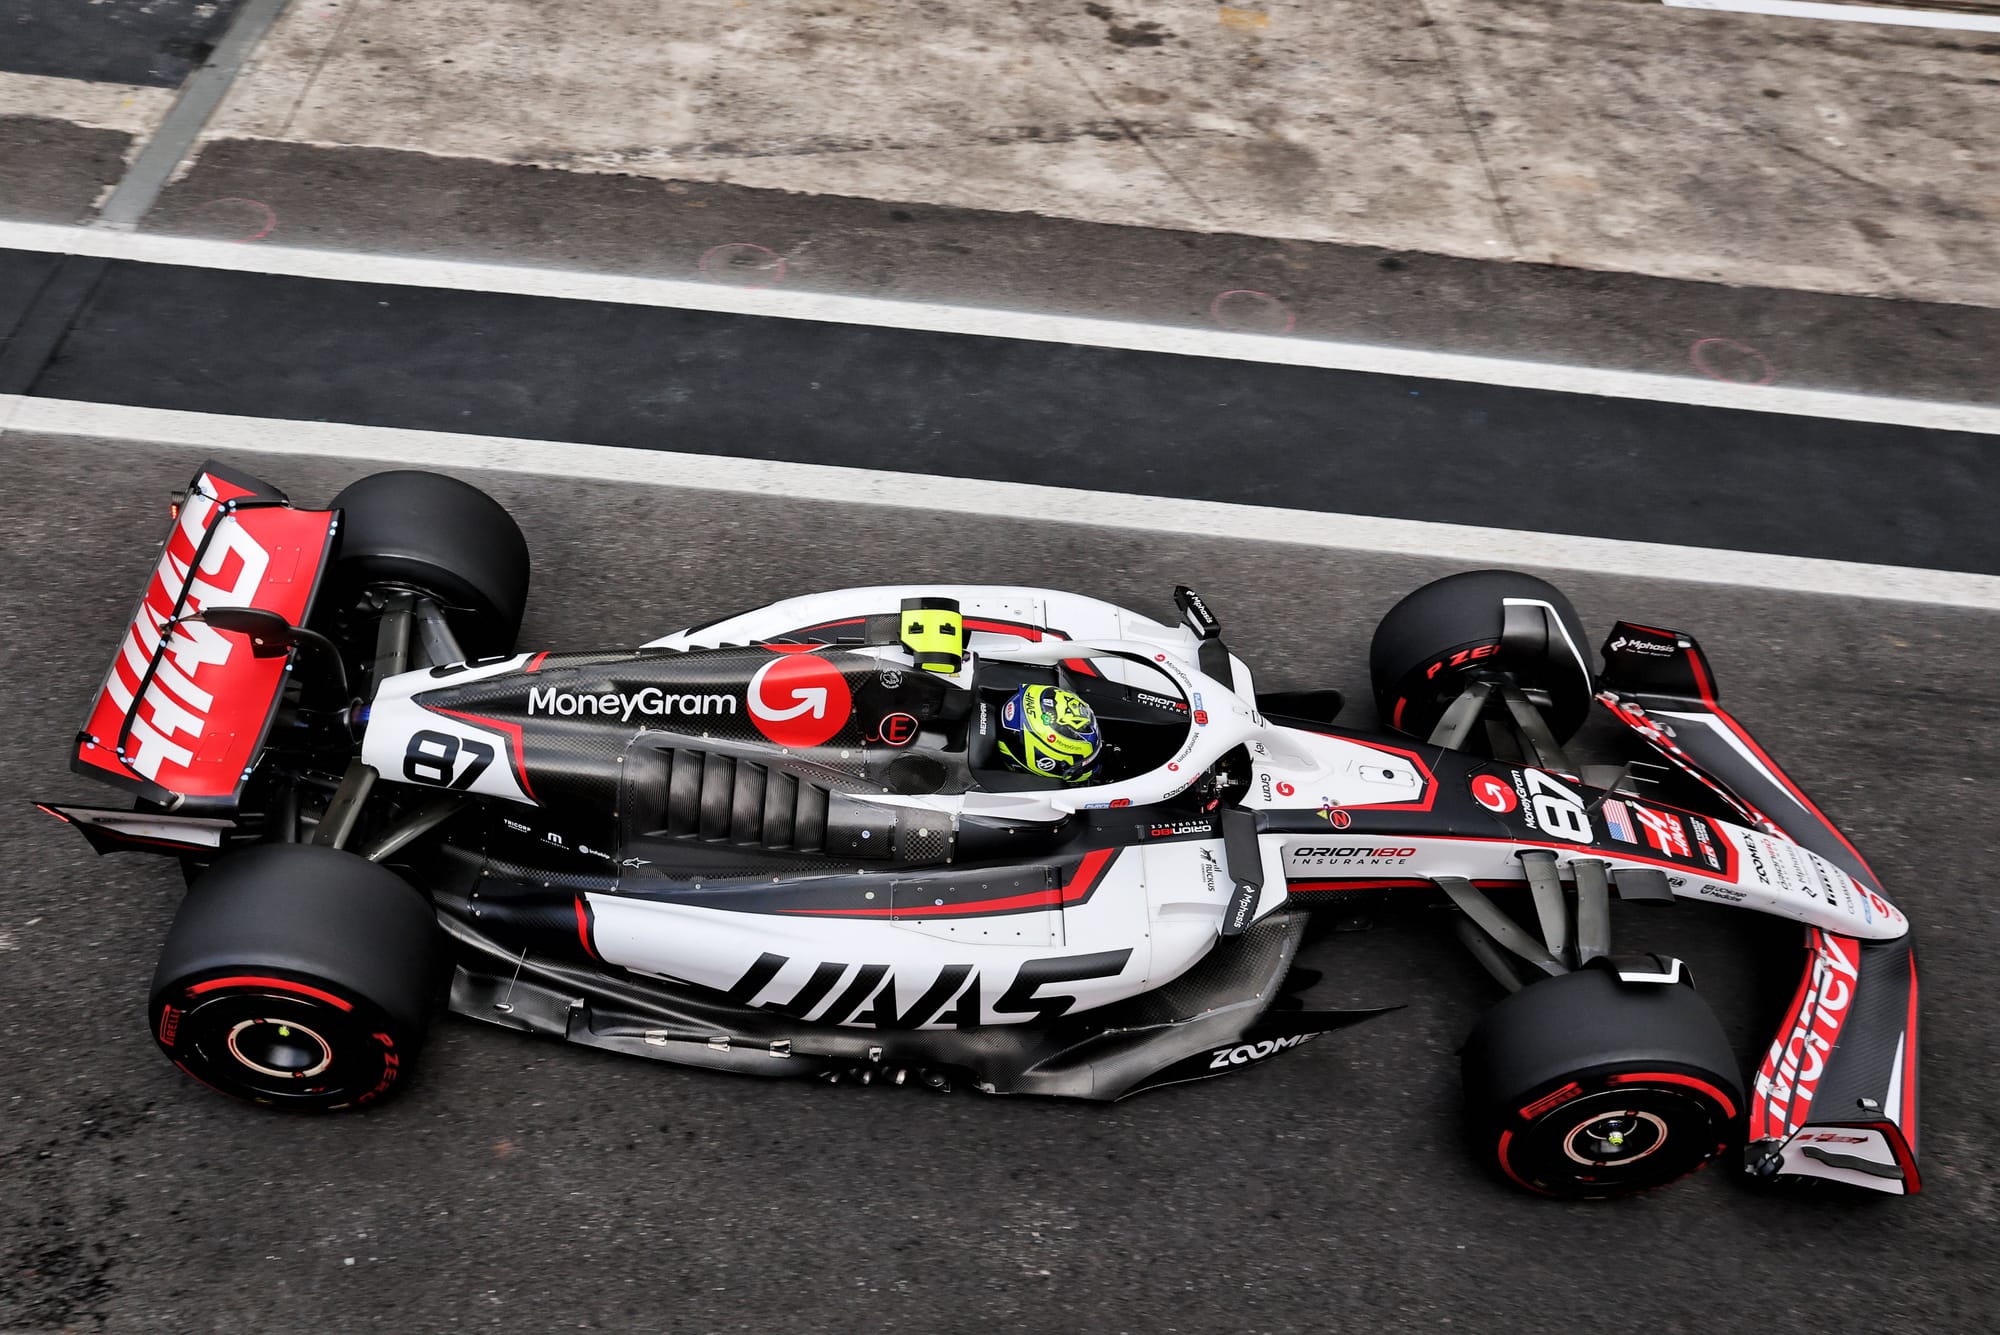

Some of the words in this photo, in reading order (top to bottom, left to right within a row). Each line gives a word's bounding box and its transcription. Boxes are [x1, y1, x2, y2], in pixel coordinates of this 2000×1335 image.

[1628, 640, 1675, 652] Mphasis
[1165, 660, 1193, 689] MoneyGram
[1427, 661, 1443, 680] P
[528, 687, 737, 721] MoneyGram
[889, 716, 910, 741] E
[403, 730, 495, 791] 87
[1176, 732, 1199, 763] MoneyGram
[1510, 769, 1538, 829] MoneyGram
[1524, 767, 1594, 844] 87
[1151, 820, 1209, 829] INSURANCE
[1151, 824, 1212, 836] ORION180
[1332, 811, 1348, 826] N
[1294, 847, 1417, 857] ORION180
[1740, 830, 1771, 886] ZOOMEX
[1205, 863, 1216, 892] RUCKUS
[1233, 893, 1253, 929] Mphasis
[727, 947, 1134, 1030] HAAS
[160, 1004, 181, 1047] PIRELLI
[1209, 1031, 1325, 1069] ZOOME
